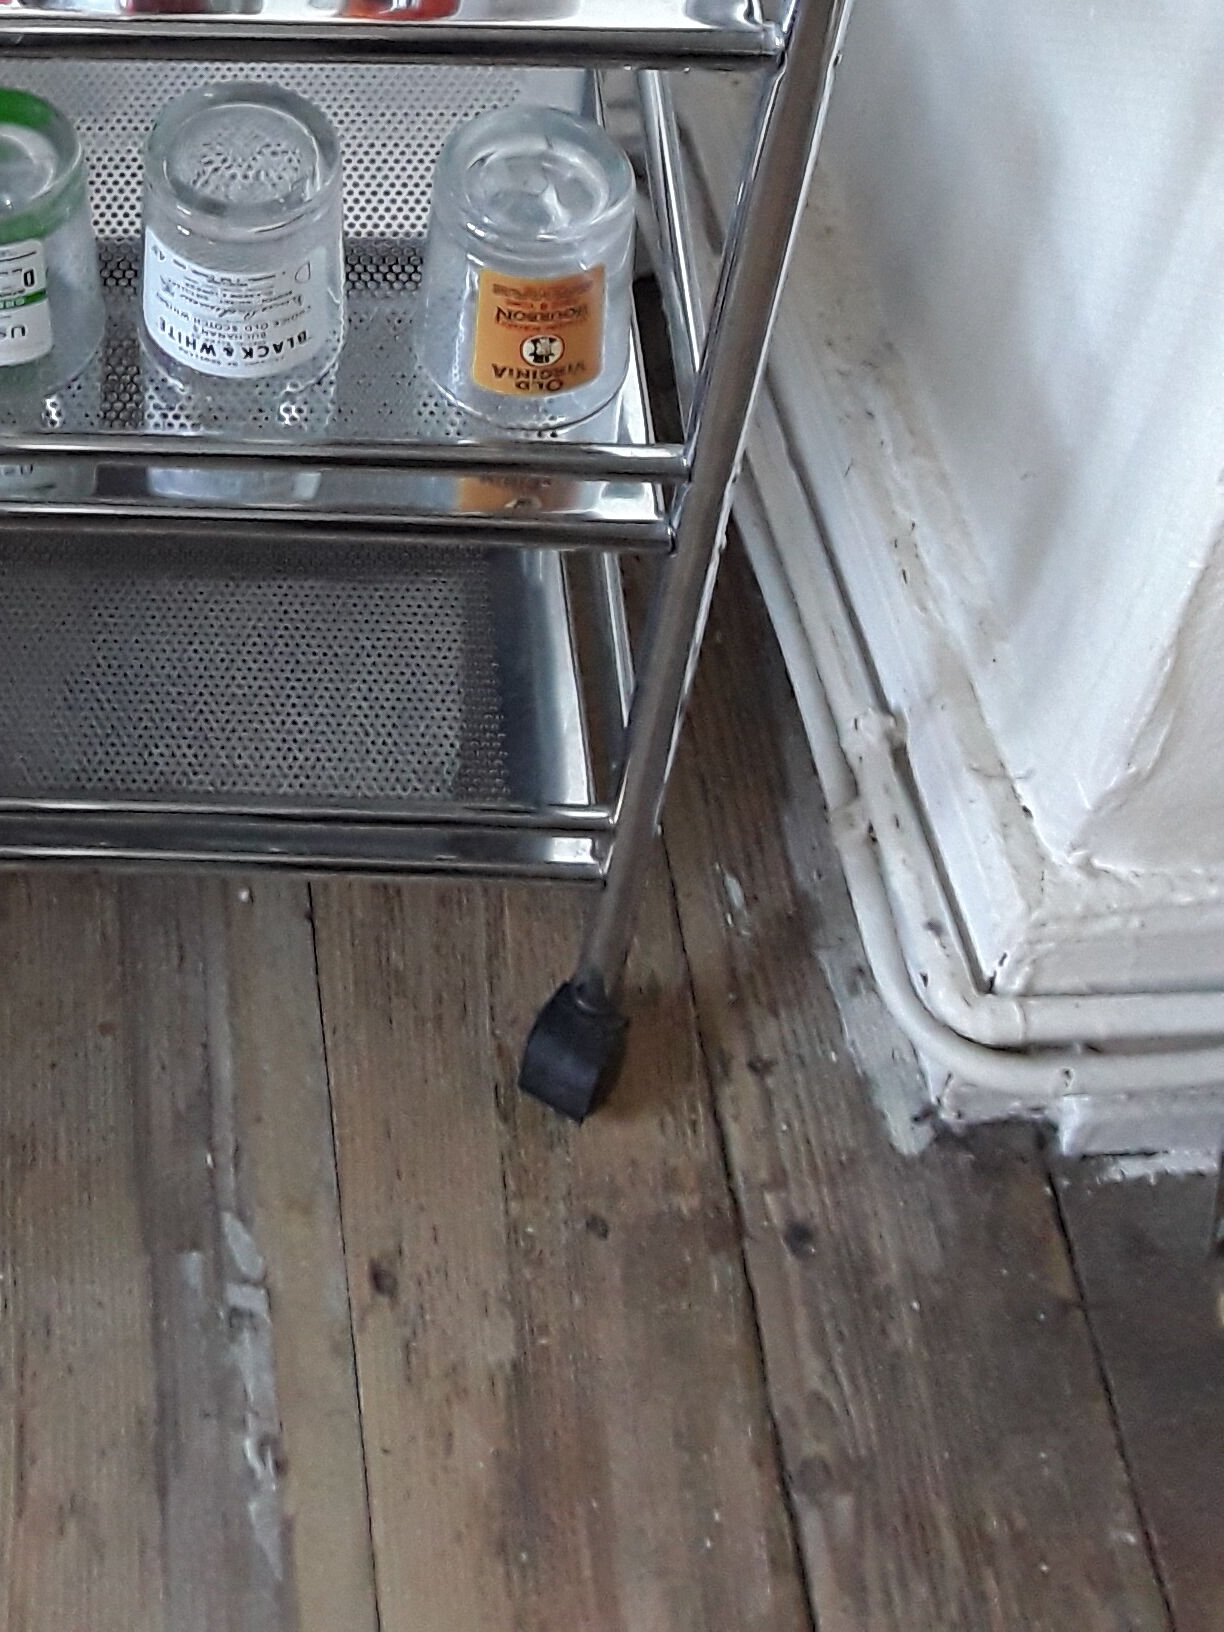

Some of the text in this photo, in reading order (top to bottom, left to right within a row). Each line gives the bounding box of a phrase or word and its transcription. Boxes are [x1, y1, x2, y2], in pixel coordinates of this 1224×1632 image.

[157, 317, 217, 357] WHITE
[241, 330, 308, 360] BLACK
[491, 363, 586, 380] VIRGINIA
[514, 379, 564, 392] OLD
